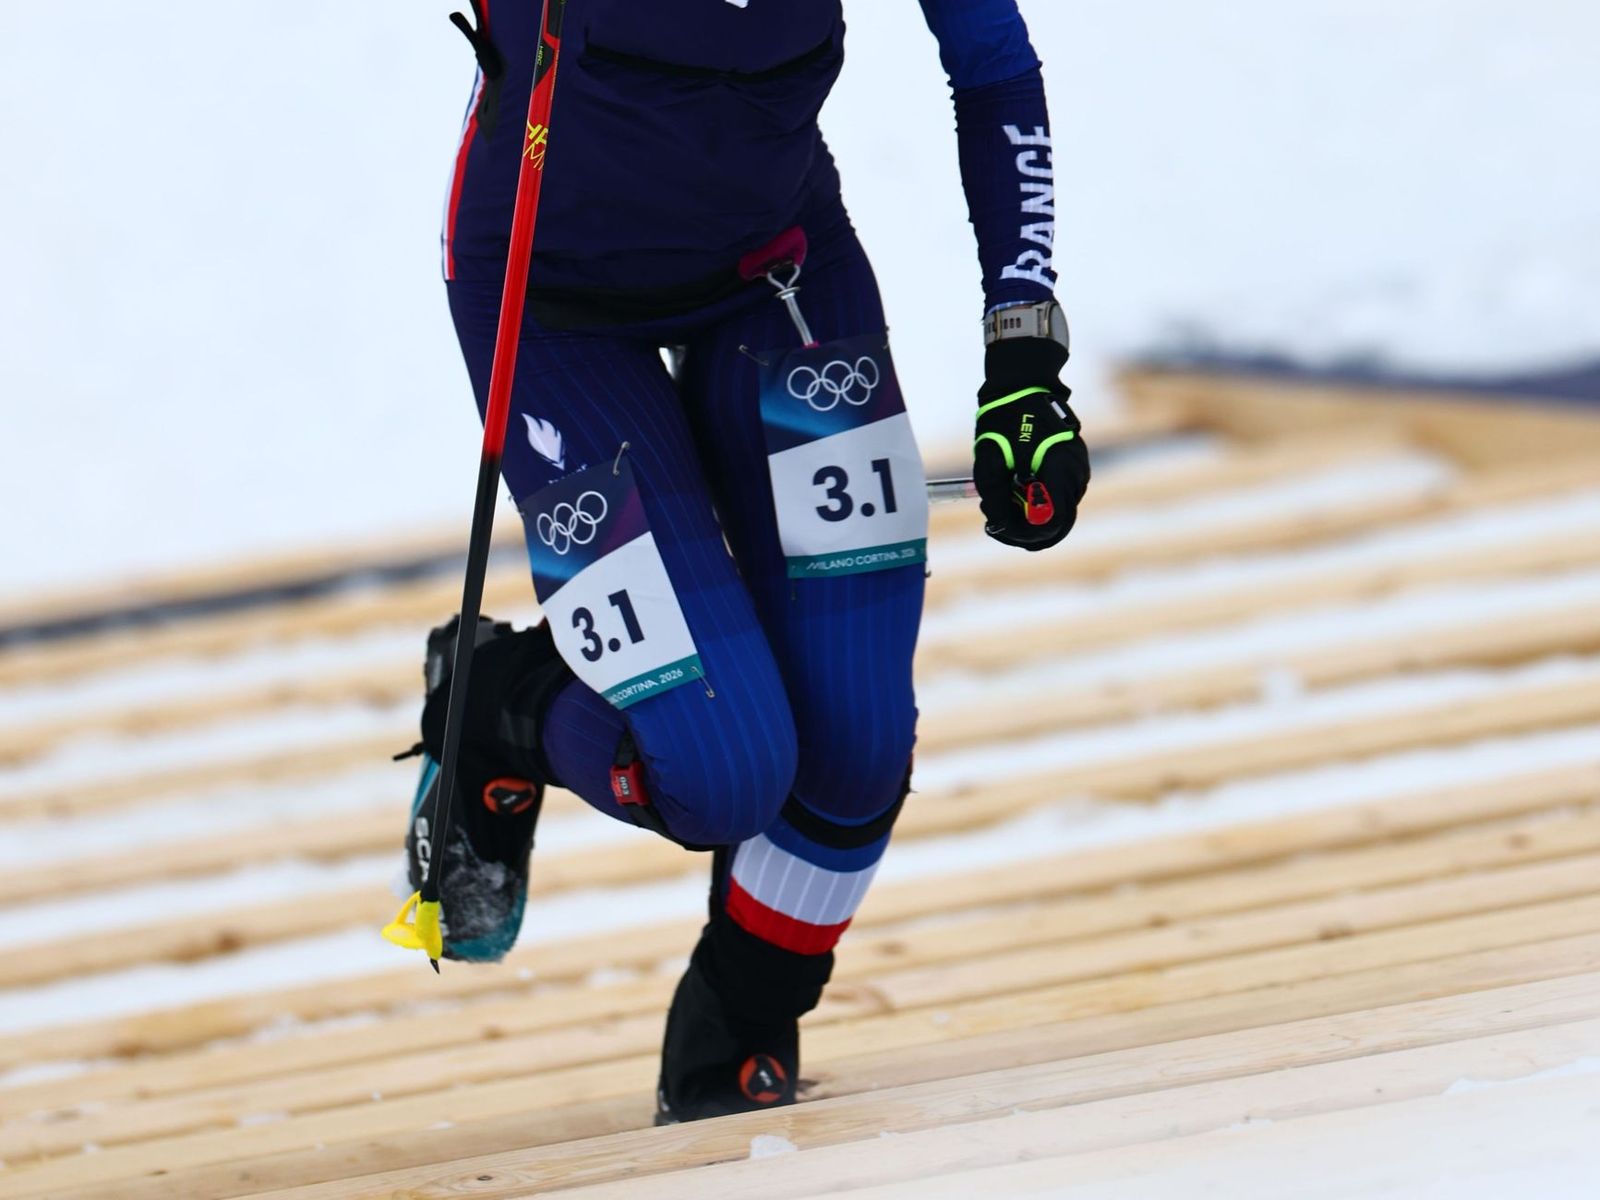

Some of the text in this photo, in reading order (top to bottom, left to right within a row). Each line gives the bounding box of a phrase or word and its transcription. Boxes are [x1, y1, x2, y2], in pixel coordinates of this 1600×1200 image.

[1018, 413, 1035, 442] LEKI
[812, 457, 898, 523] 3.1
[806, 557, 854, 571] MILANO
[855, 550, 900, 566] CORTINA
[571, 588, 645, 663] 3.1
[658, 668, 684, 684] 2026
